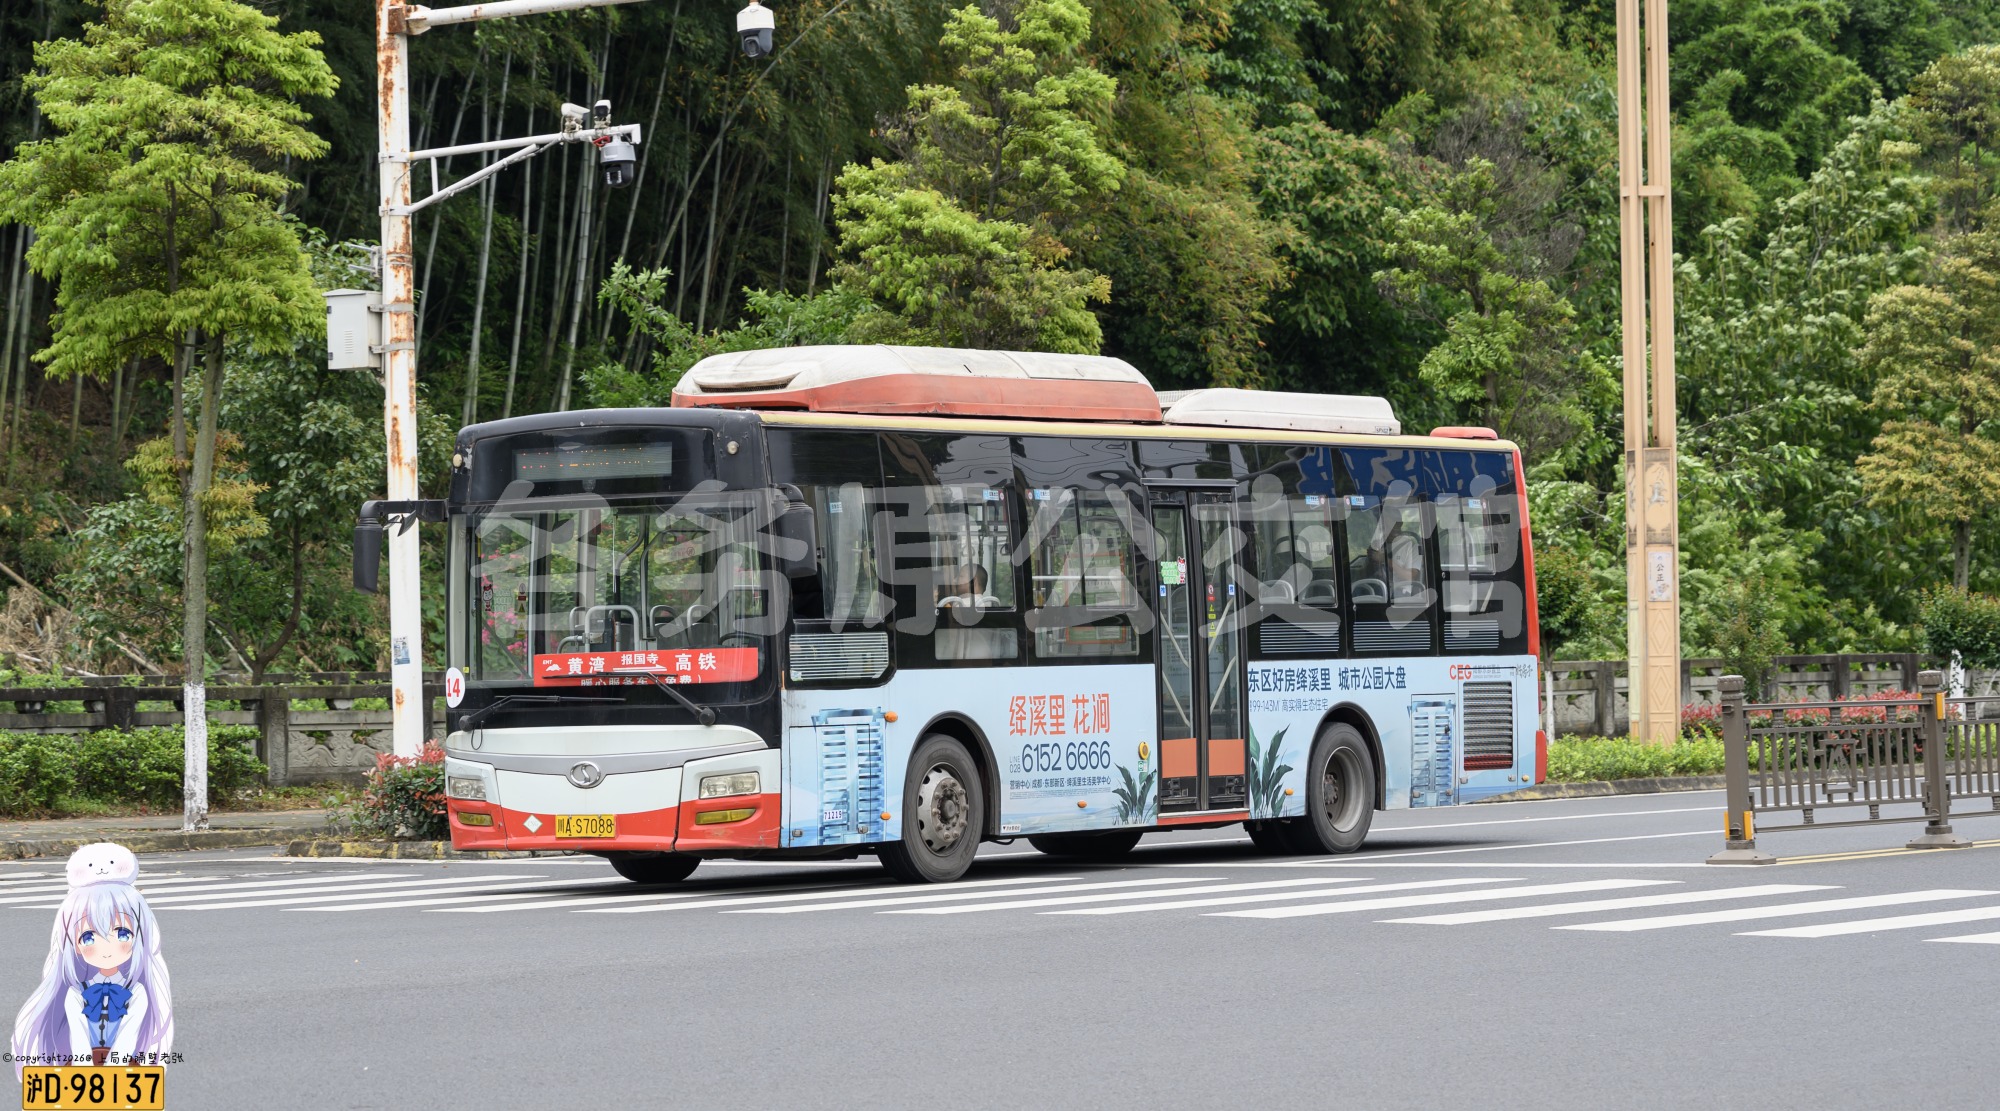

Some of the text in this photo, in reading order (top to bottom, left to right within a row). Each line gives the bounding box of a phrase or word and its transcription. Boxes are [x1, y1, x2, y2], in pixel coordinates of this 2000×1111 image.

[567, 652, 717, 675] 黄湾 报国寺 高铁
[1449, 664, 1473, 681] CEG
[447, 678, 460, 697] 14
[1338, 665, 1407, 690] 城市公园大盘
[1009, 694, 1066, 736] 绛溪里
[1009, 740, 1111, 773] 028 6152 6666
